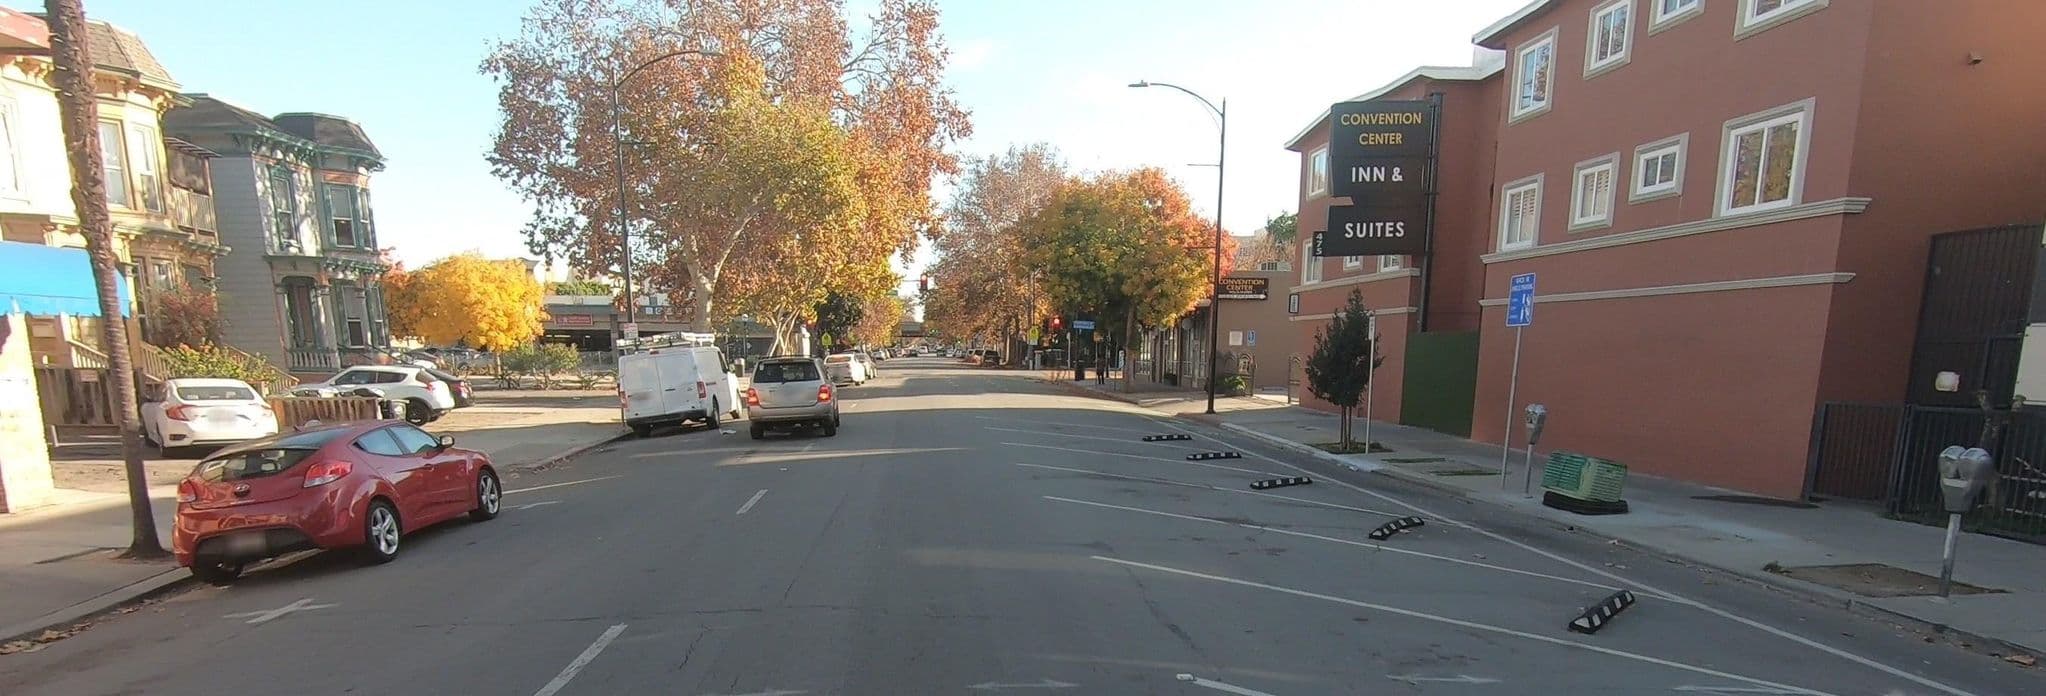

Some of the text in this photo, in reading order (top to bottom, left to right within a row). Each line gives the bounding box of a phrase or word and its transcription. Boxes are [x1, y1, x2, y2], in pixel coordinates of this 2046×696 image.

[1341, 113, 1422, 126] CONVENTION
[1359, 133, 1402, 145] CENTER
[1352, 167, 1403, 182] INN &
[1345, 222, 1405, 238] SUITES
[1315, 232, 1323, 255] 475
